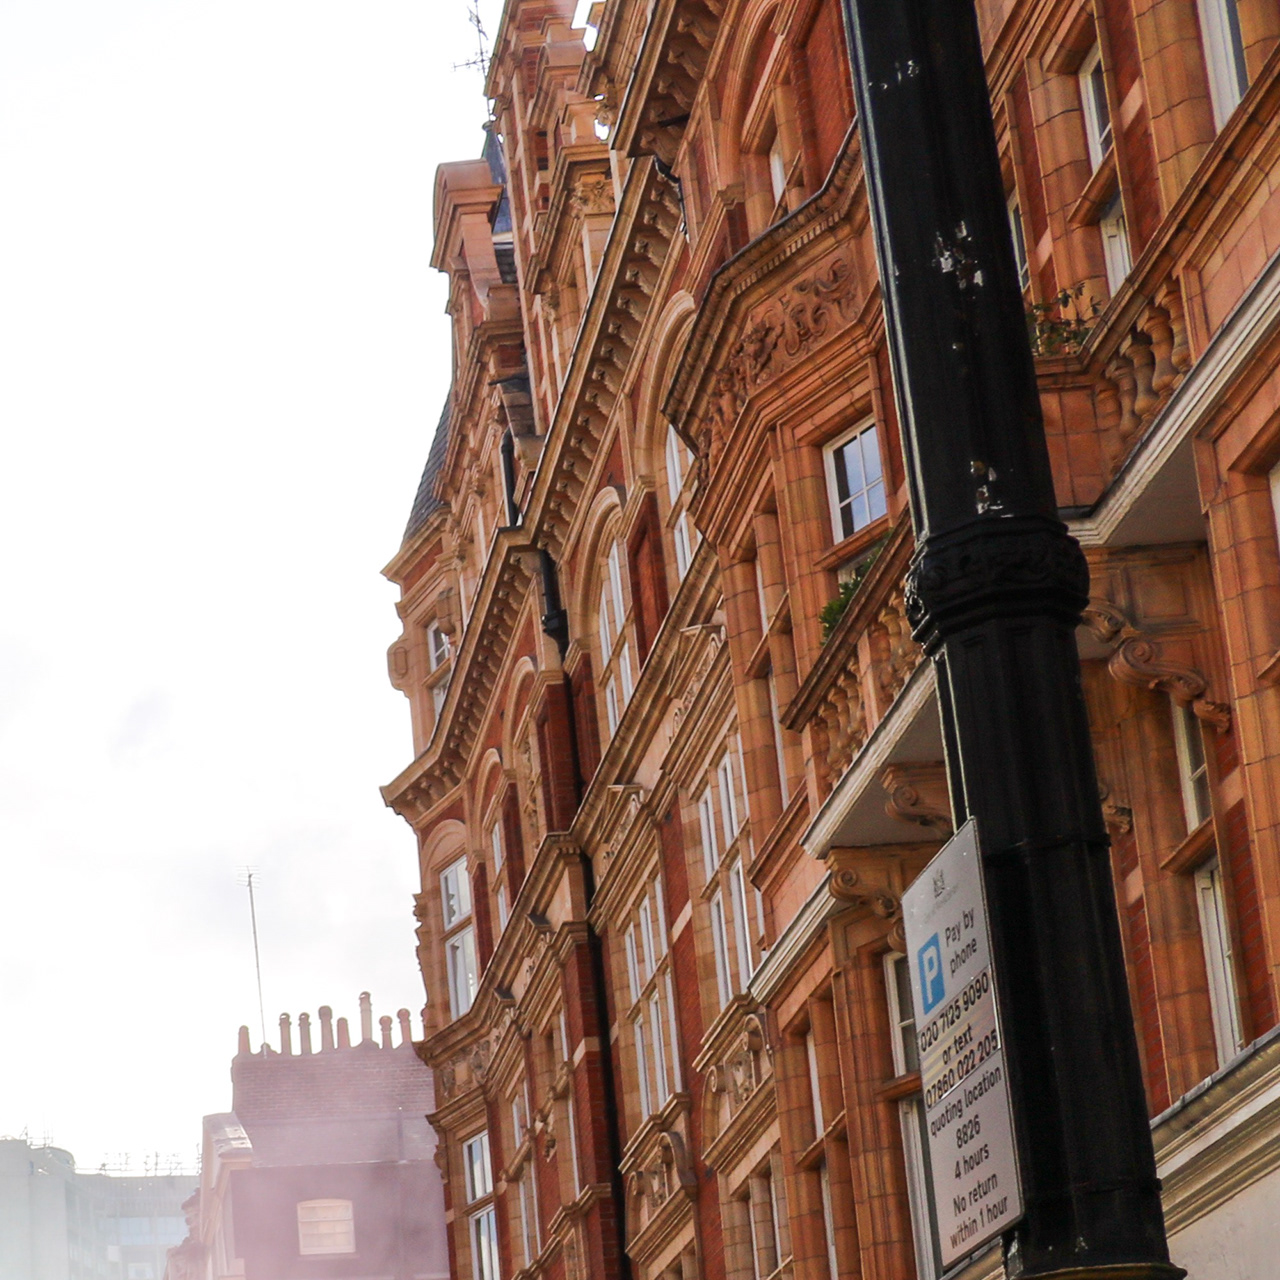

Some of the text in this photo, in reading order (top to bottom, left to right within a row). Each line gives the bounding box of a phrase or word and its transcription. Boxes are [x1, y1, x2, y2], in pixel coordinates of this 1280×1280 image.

[945, 907, 974, 948] Pay by
[923, 945, 939, 1005] P
[949, 937, 977, 978] phone
[920, 970, 989, 1053] 020 7125 9090
[942, 1023, 973, 1066] or text
[956, 1055, 976, 1082] 022
[978, 1030, 999, 1064] 205
[930, 1066, 1002, 1138] quoting location
[956, 1114, 981, 1149] 8826
[954, 1143, 990, 1180] 4 hours
[953, 1172, 998, 1218] No return
[950, 1195, 1008, 1250] within 1 hour
